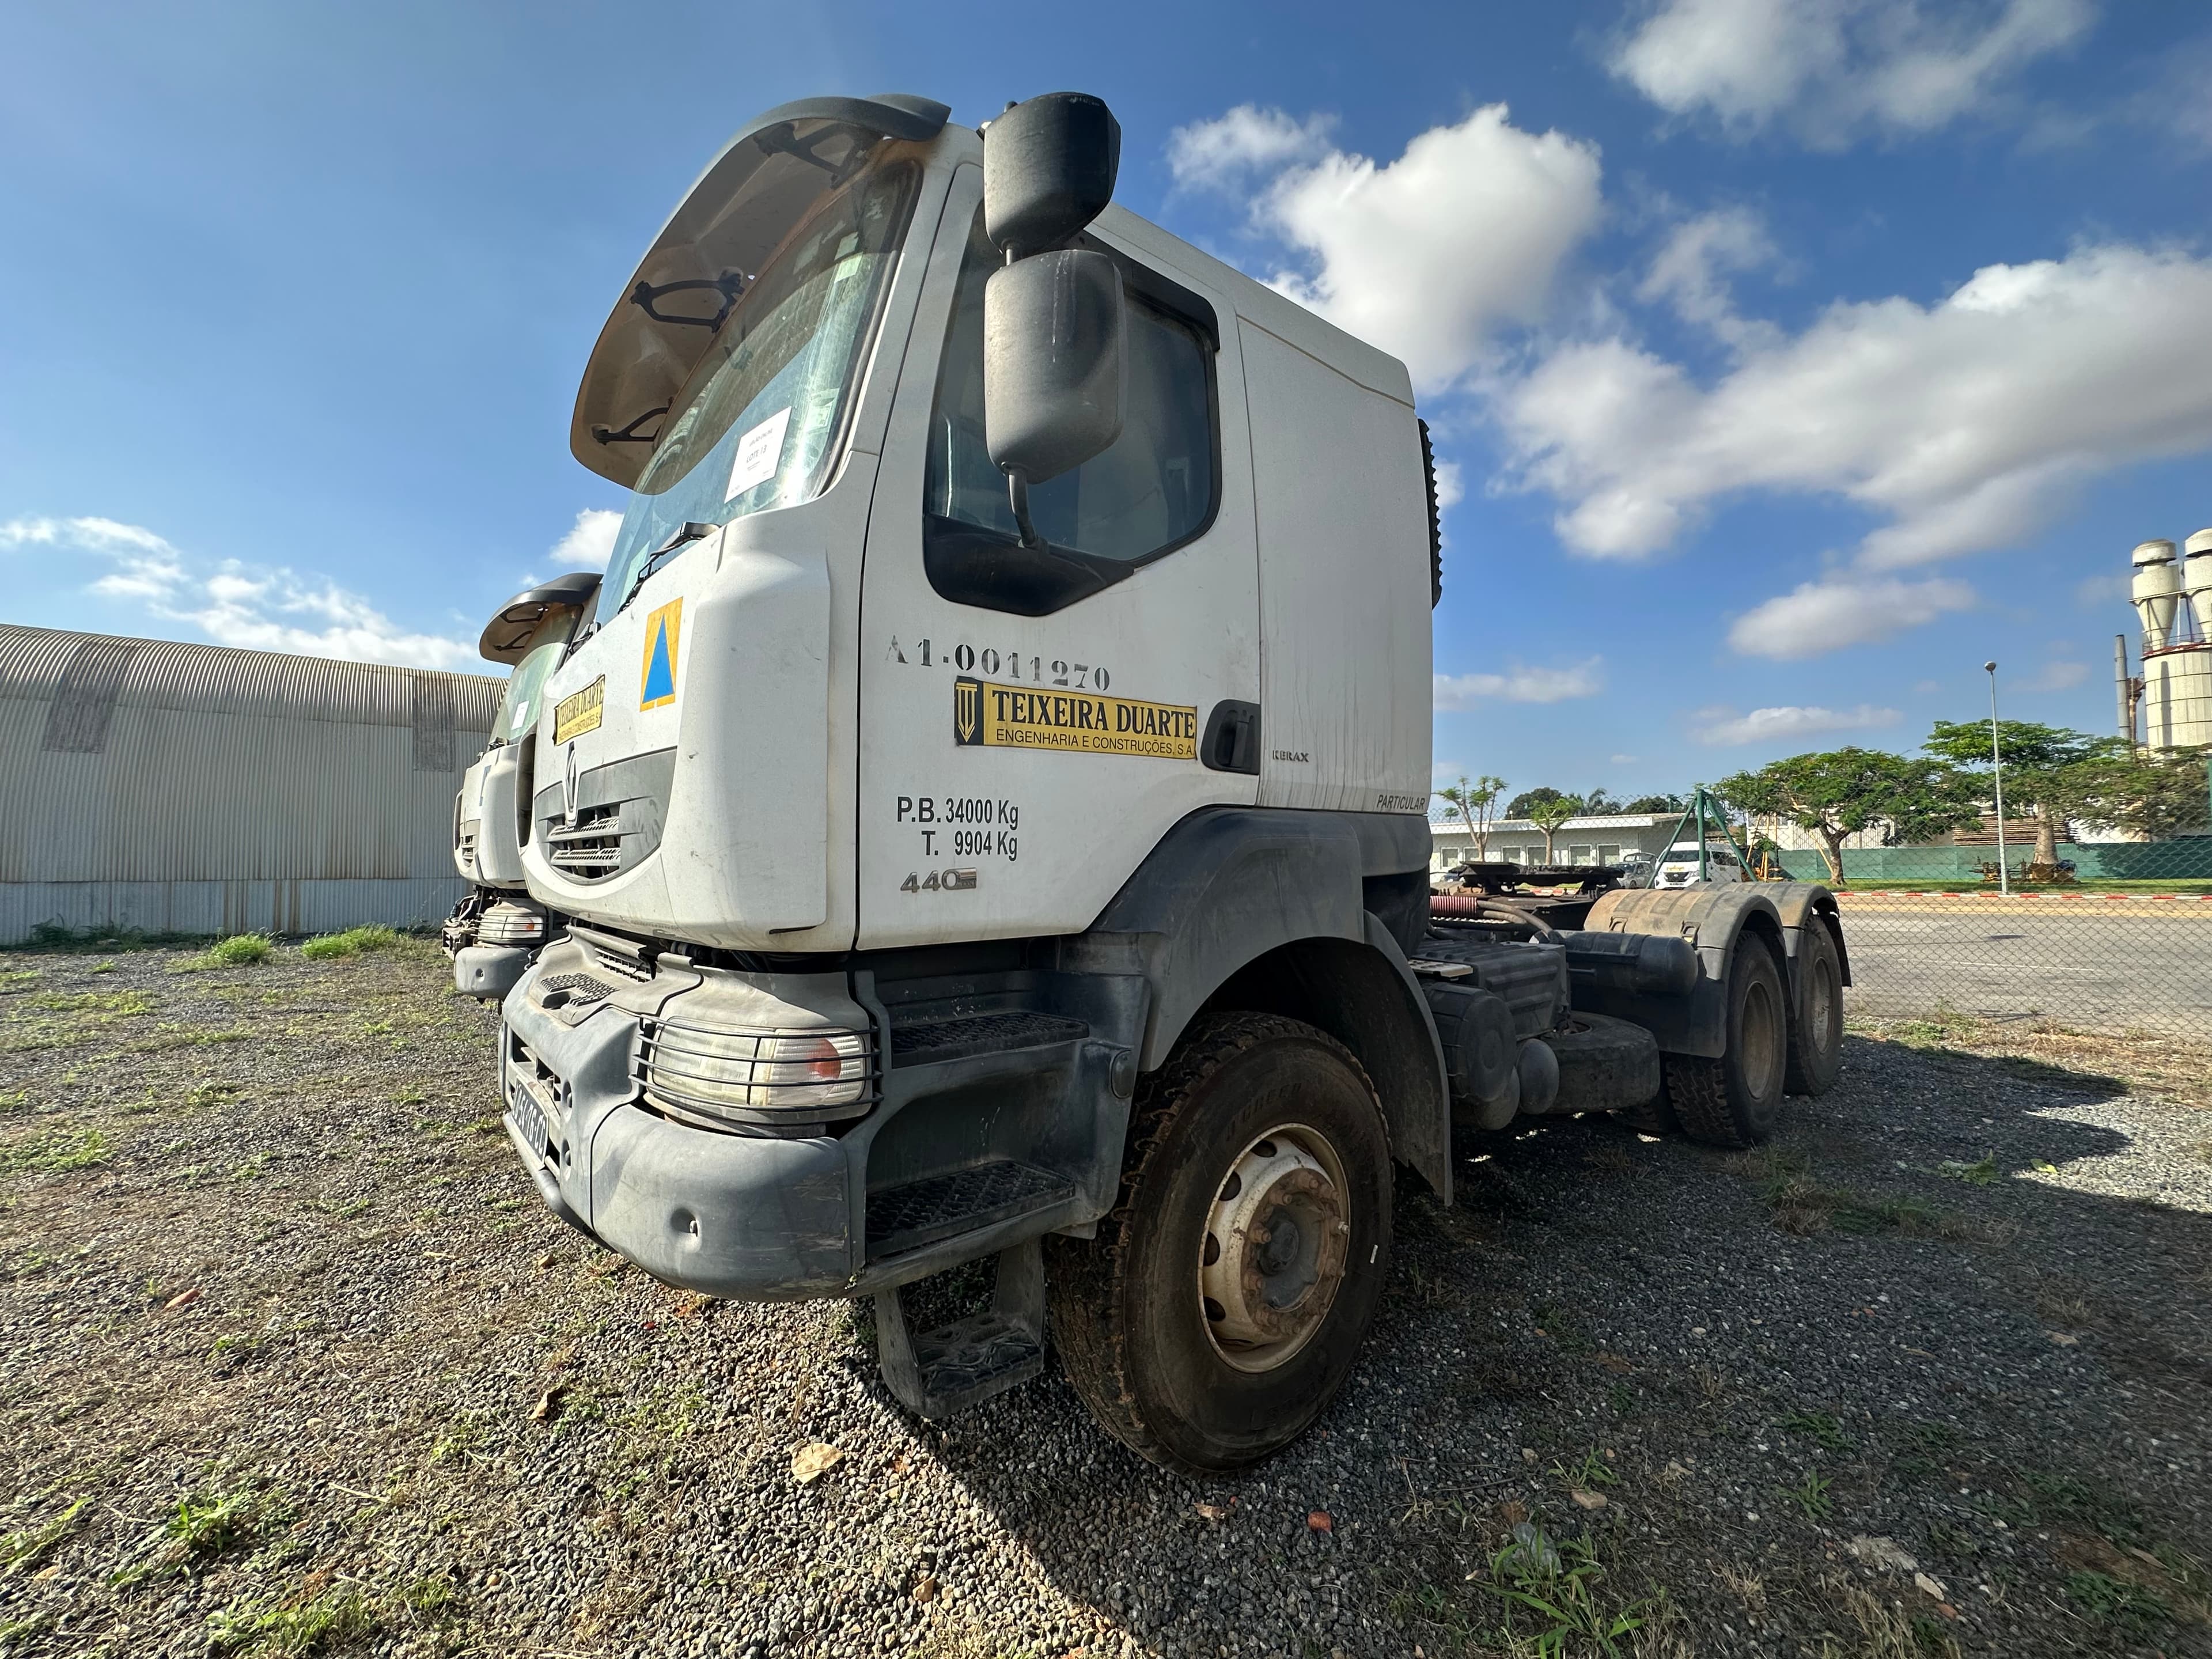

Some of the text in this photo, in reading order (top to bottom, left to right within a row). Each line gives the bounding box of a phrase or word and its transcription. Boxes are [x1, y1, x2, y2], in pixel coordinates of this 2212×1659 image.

[992, 690, 1195, 739] TEIXEIRA DUARTE
[997, 729, 1078, 747] ENGENHARIA
[1082, 736, 1089, 747] E
[1093, 736, 1175, 755] CONSTRUÇÕES,
[1272, 750, 1309, 762] KERAX
[897, 796, 1018, 830] P.B. 34000 Kg
[1377, 794, 1425, 810] PARTICULAR
[922, 831, 1017, 861] T. 9904 Kg
[900, 869, 961, 893] 440
